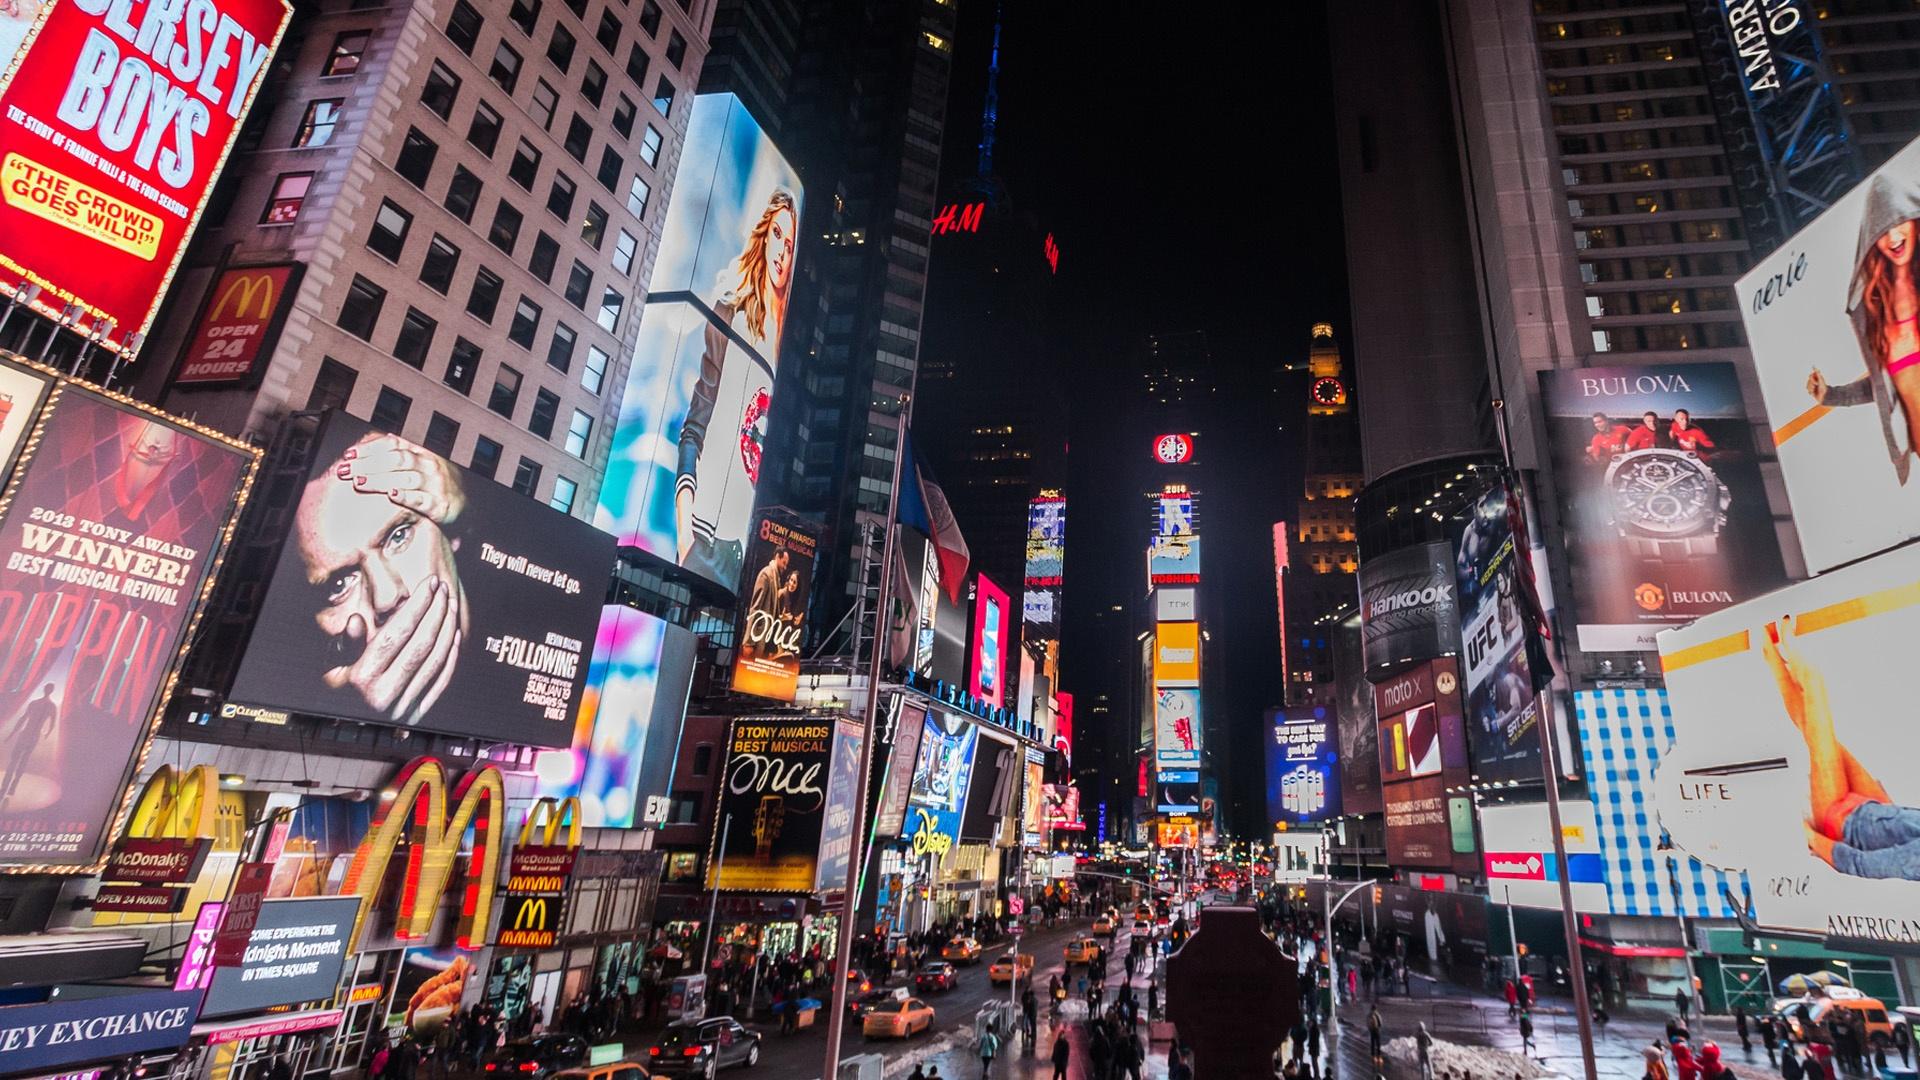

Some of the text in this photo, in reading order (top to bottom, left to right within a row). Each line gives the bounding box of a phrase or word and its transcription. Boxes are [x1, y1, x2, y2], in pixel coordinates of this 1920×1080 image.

[1725, 0, 1780, 92] AMER
[72, 0, 269, 119] ERSEY
[57, 27, 209, 189] BOYS
[6, 104, 189, 219] THE STORY OF FRANKIE VALLI & THE FOUR SEASONS
[12, 179, 79, 217] GOES
[76, 189, 154, 233] CROWD
[931, 202, 985, 235] H&M
[1752, 251, 1809, 315] aerie
[207, 324, 260, 338] OPEN
[202, 338, 247, 359] 24
[184, 361, 250, 375] HOURS
[1581, 374, 1692, 397] BULOVA
[29, 506, 198, 561] 2013 TONY AWARD
[760, 519, 771, 541] 8
[771, 523, 816, 548] TONY AWARDS
[21, 522, 192, 587] WINNER!
[769, 534, 815, 558] BEST MUSICAL
[6, 551, 179, 607] BEST MUSICAL REVIVAL
[481, 542, 581, 597] They will never let go.
[1152, 574, 1200, 584] TOSHIBA
[1672, 590, 1733, 604] BULOVA
[1467, 614, 1498, 672] UFC
[1637, 635, 1657, 644] Ava
[485, 635, 580, 680] THE FOLLOWING
[523, 692, 557, 707] MONDAYS
[737, 727, 745, 738] 8
[746, 727, 777, 738] TONY
[778, 726, 829, 739] AWARDS
[735, 742, 827, 753] BEST MUSICAL
[1679, 783, 1731, 800] LIFE
[214, 804, 243, 816] WL
[113, 851, 188, 869] McDonald's
[513, 854, 572, 864] McDonald's
[520, 864, 560, 872] Restaurant
[116, 867, 171, 878] Restaurant
[96, 895, 169, 905] OPEN 24 HOURS
[229, 891, 264, 911] JERSEY
[226, 911, 255, 931] BOYS
[273, 925, 321, 940] EXPERIENCE
[320, 924, 337, 936] THE
[242, 939, 342, 966] idnight Moment
[241, 961, 320, 982] IN TIMES SQUARE
[0, 1006, 190, 1052] EY EXCHANGE
